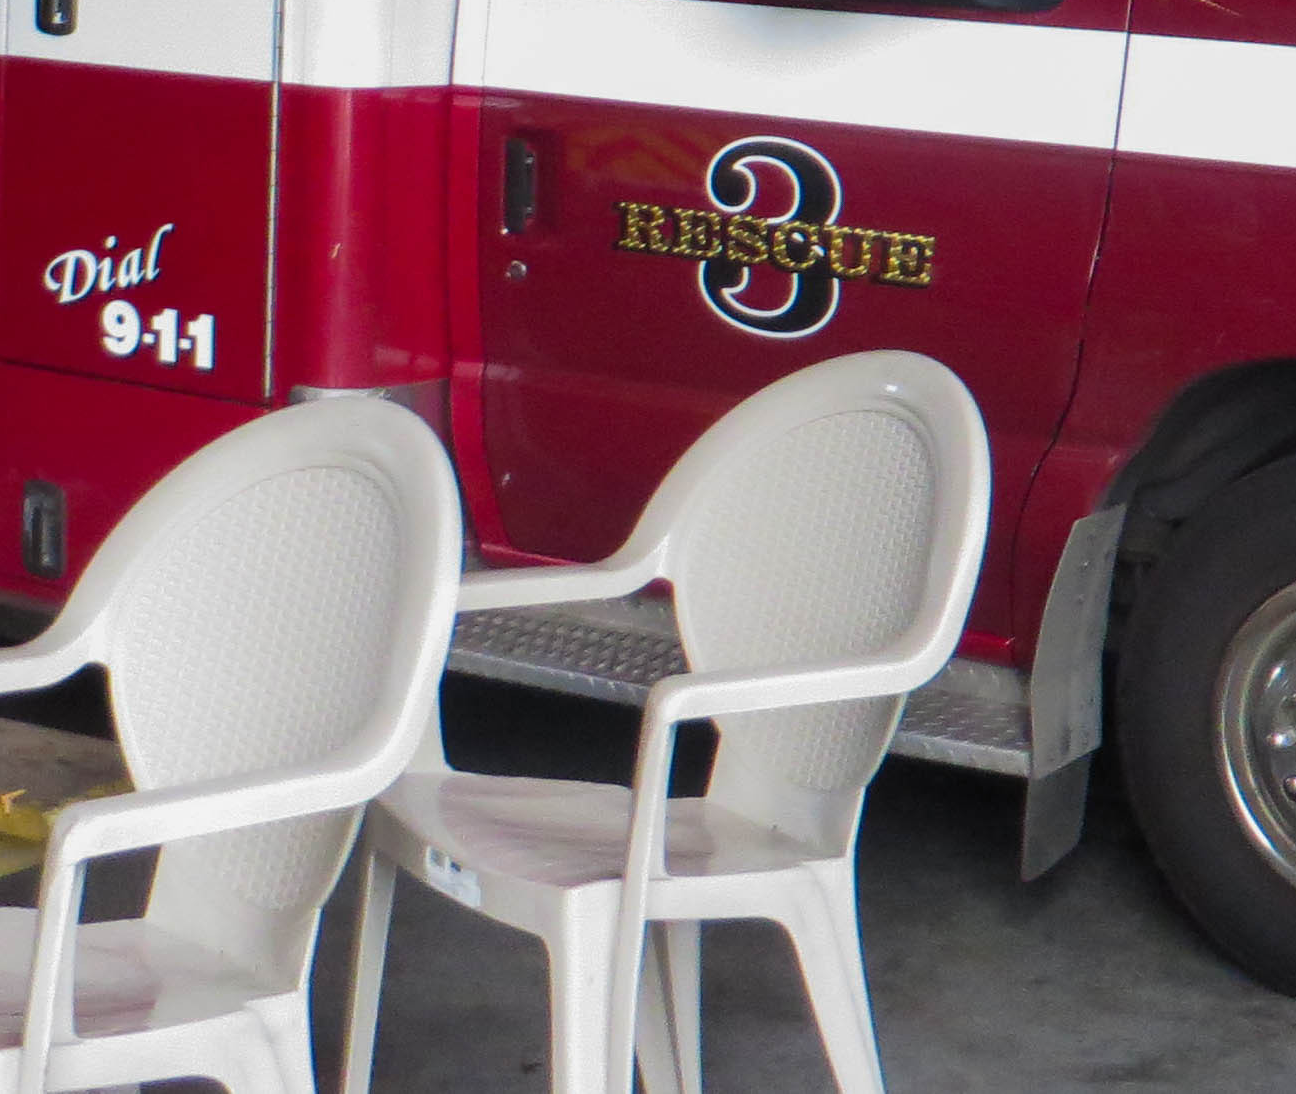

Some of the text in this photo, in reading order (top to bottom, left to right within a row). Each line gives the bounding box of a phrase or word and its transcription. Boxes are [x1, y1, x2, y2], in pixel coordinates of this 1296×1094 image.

[44, 222, 175, 304] Dial
[613, 201, 937, 287] RESCUE
[698, 135, 843, 339] 3
